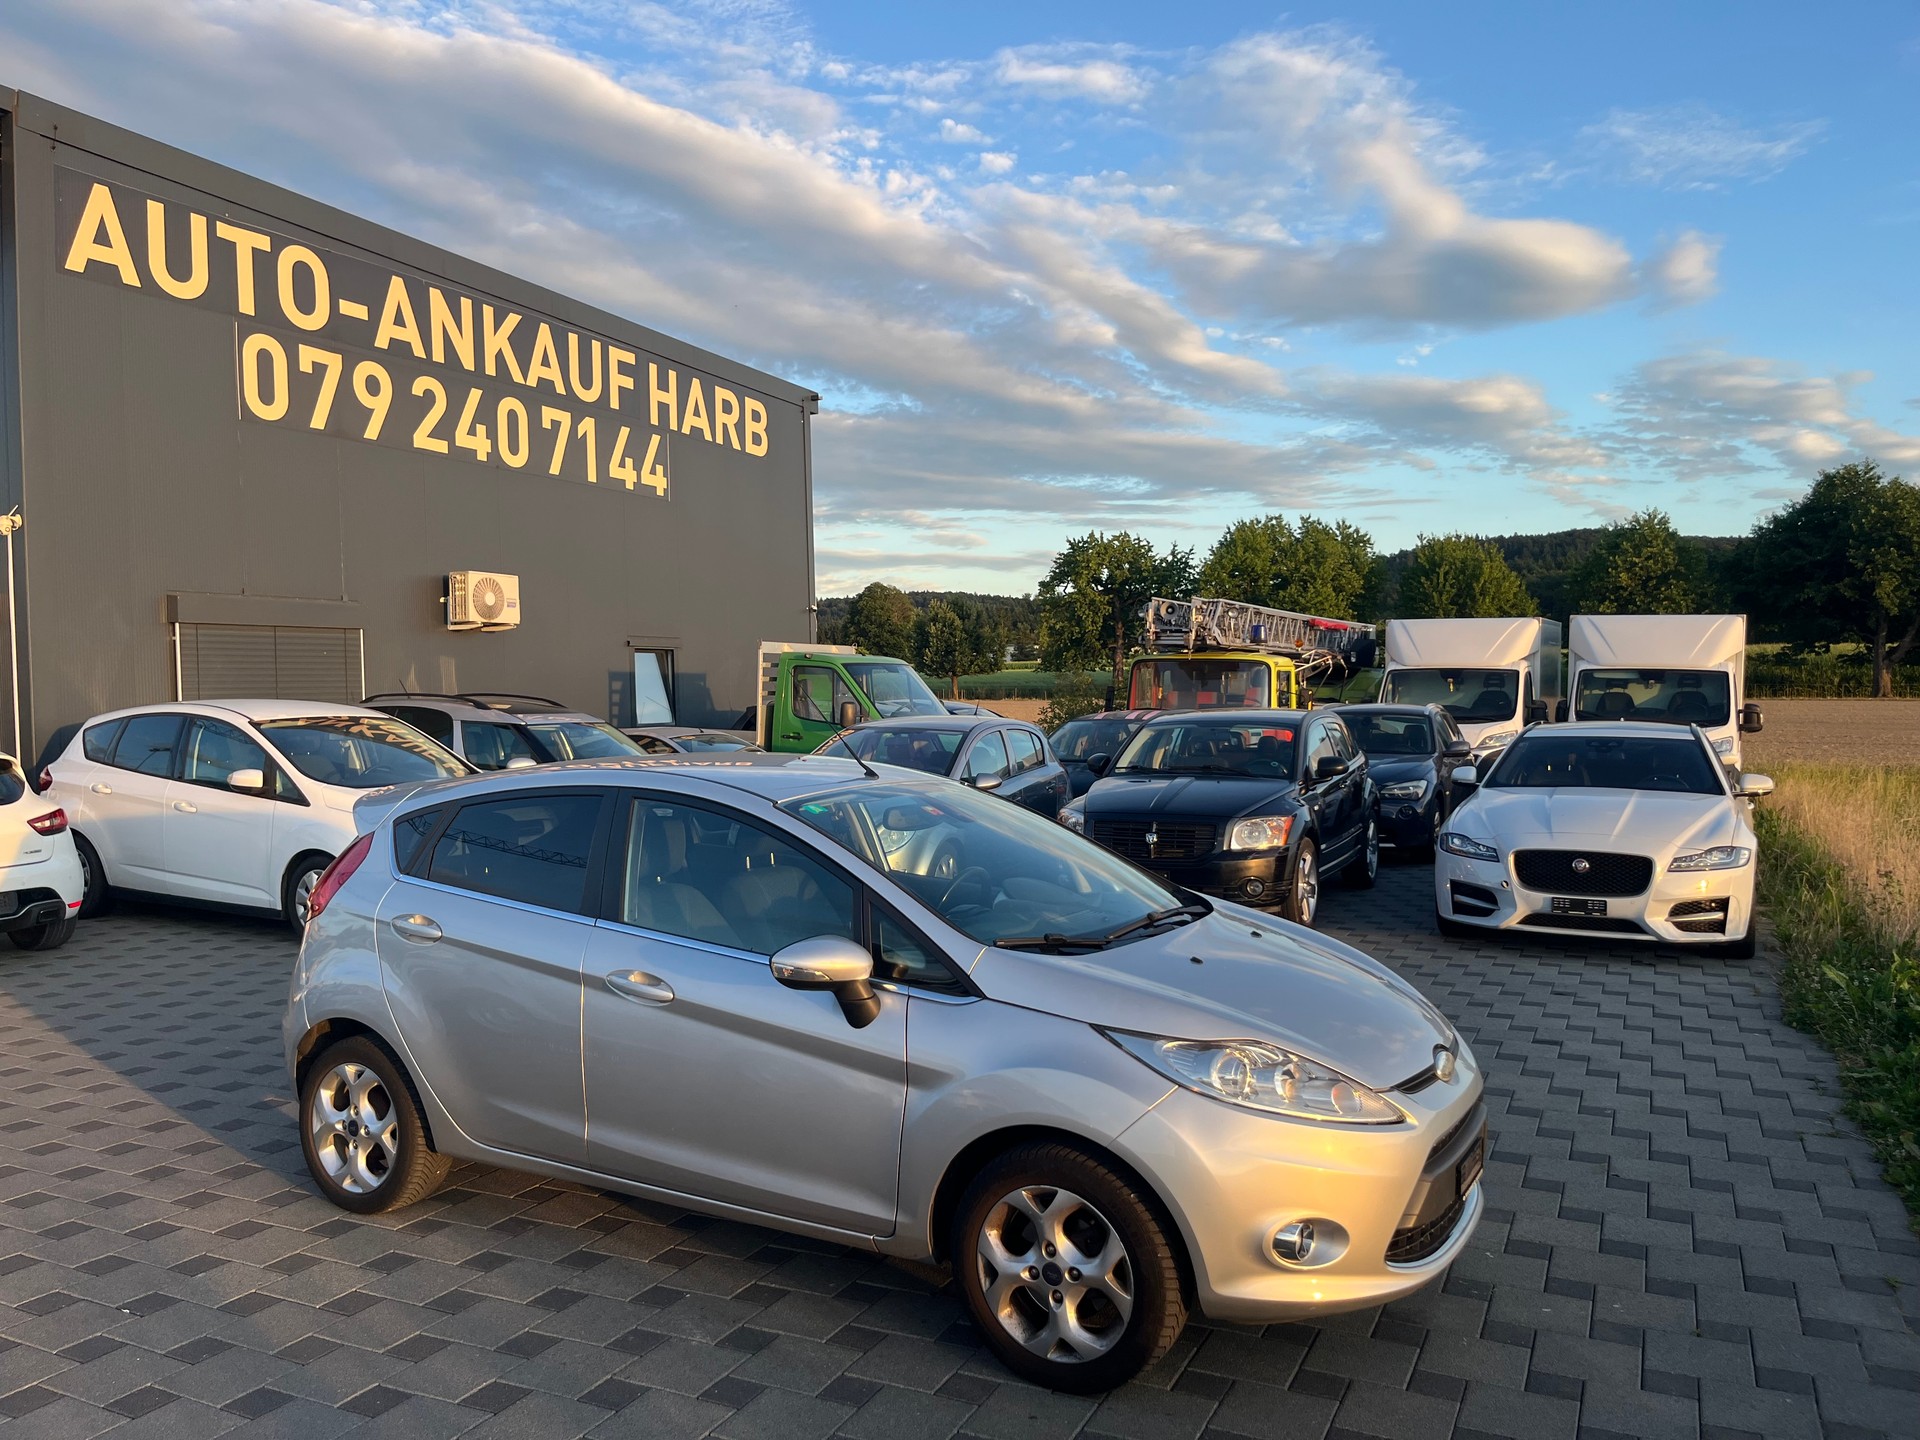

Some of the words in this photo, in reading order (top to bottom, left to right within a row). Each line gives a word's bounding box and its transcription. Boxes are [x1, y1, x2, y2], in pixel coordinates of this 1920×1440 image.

[65, 183, 636, 409] AUTO-ANKAUF
[649, 363, 769, 457] HARB
[242, 333, 393, 441] 079
[411, 375, 530, 468] 240
